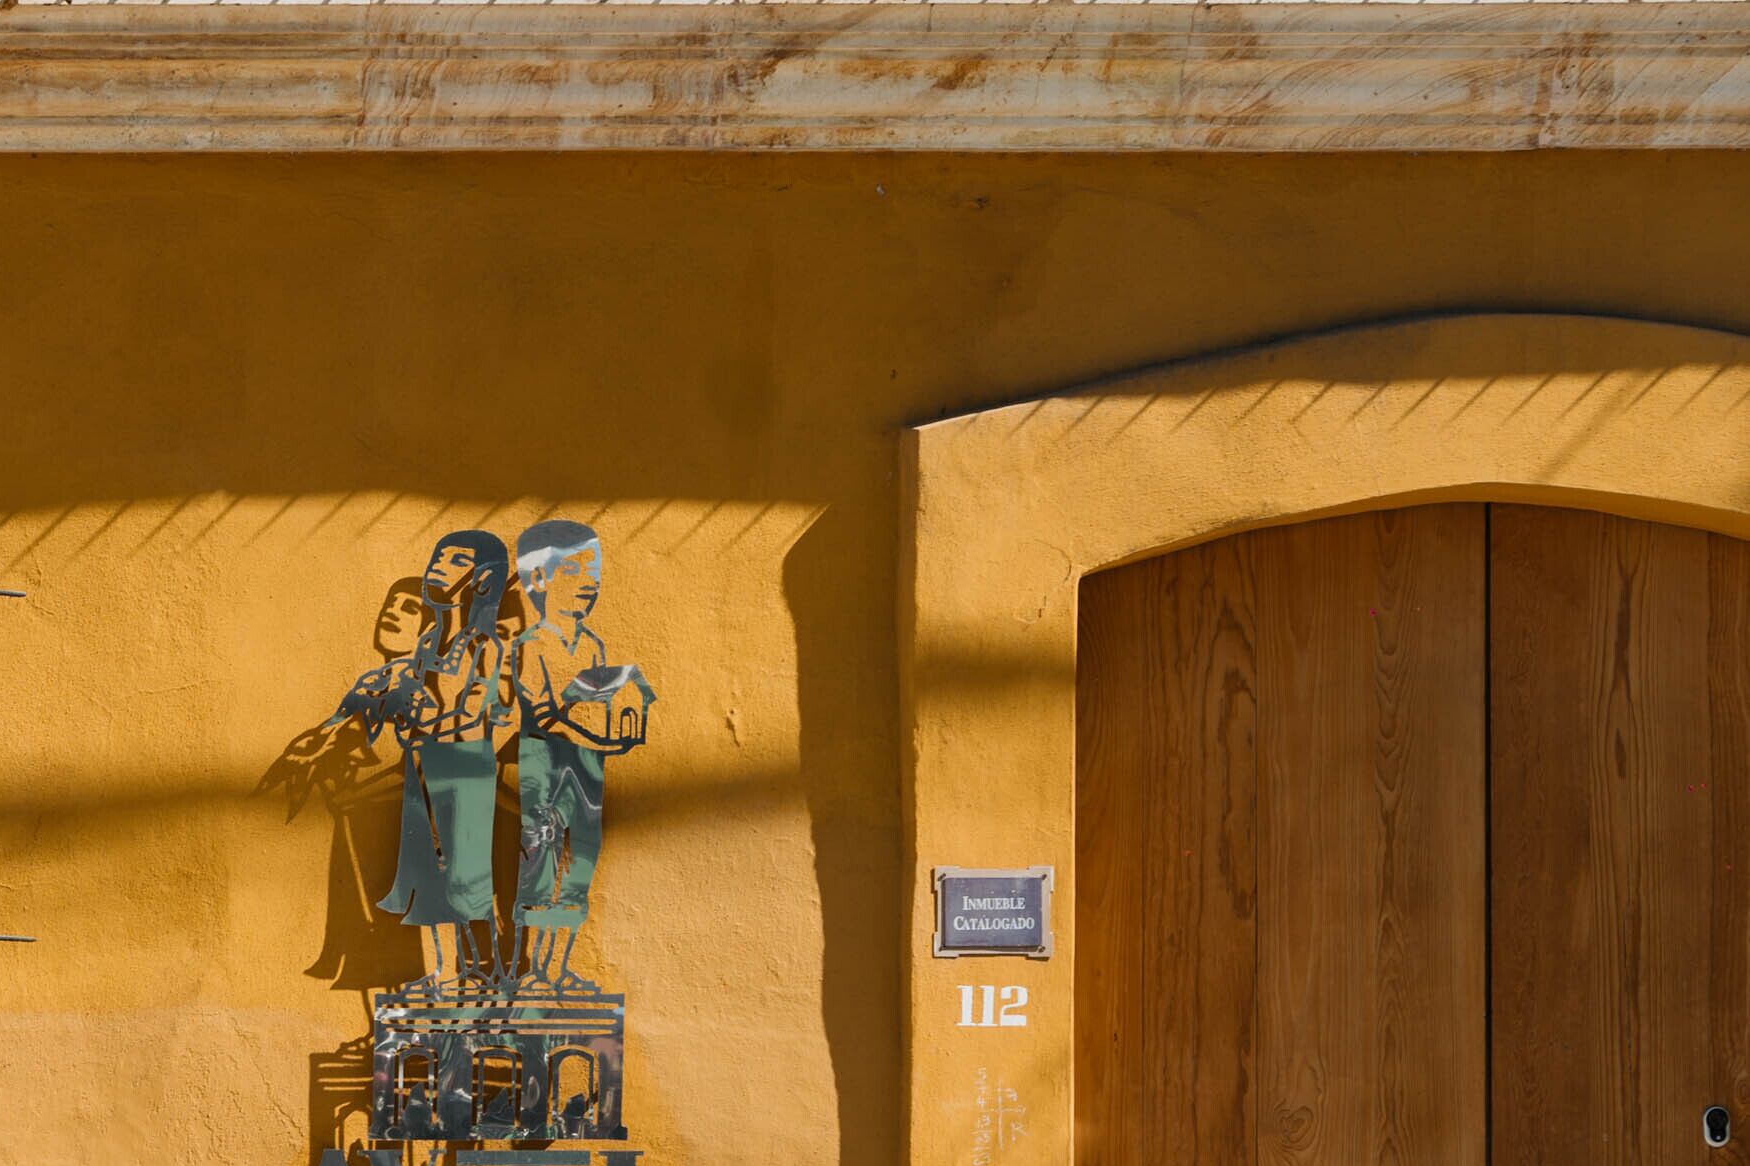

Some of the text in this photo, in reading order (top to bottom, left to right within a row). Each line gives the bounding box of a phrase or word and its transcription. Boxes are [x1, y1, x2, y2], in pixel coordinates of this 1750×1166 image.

[962, 895, 1026, 911] INMUEBLE
[953, 915, 1035, 932] CATALOGADO
[955, 984, 1029, 1027] 112
